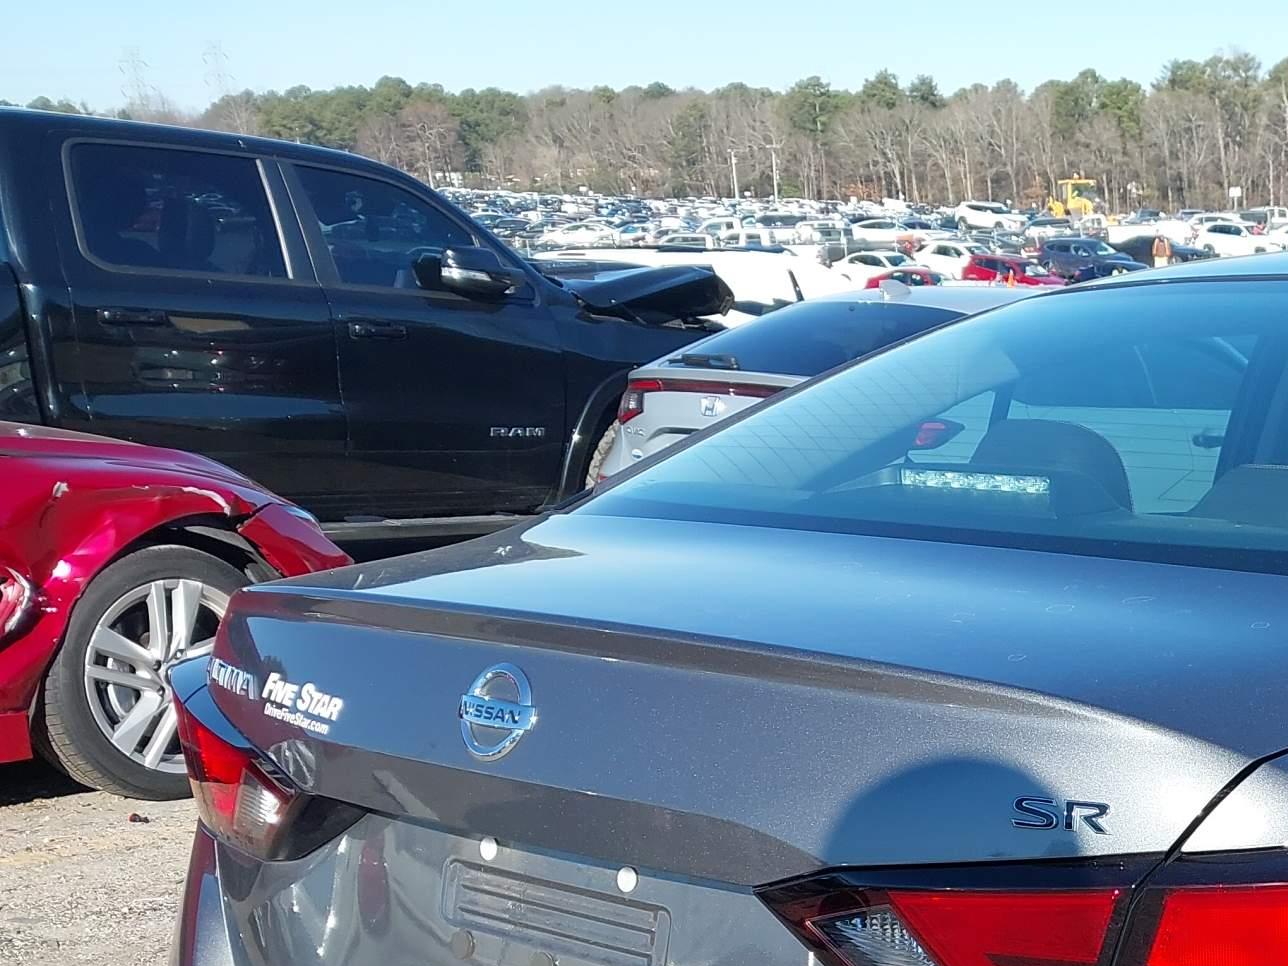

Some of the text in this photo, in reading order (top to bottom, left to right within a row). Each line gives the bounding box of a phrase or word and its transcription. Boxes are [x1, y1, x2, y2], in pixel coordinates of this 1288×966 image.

[489, 426, 545, 437] RAM
[263, 702, 330, 735] DriveFiveStar.com
[462, 699, 522, 725] NISSAN
[1011, 796, 1113, 835] SR
